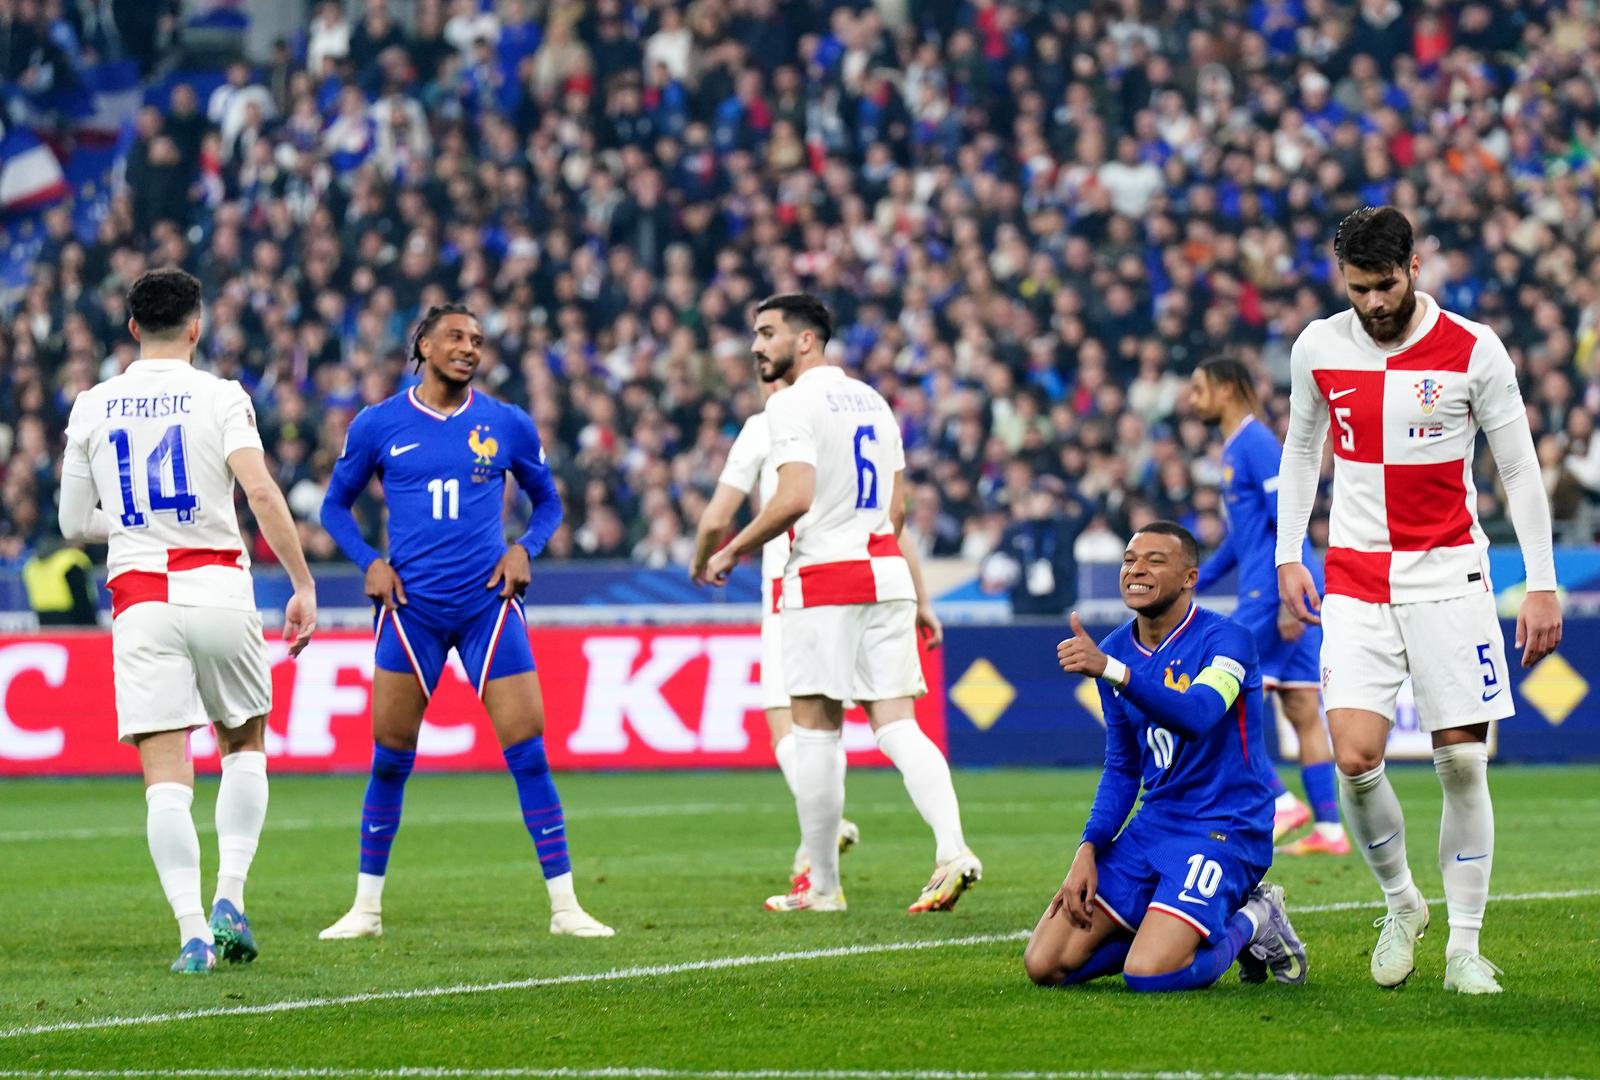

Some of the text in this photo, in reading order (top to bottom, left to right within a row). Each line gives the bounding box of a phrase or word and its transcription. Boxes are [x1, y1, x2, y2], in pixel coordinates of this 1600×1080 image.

[1334, 407, 1356, 452] 5
[108, 423, 201, 529] 14
[853, 424, 880, 511] 6
[427, 478, 460, 520] 11
[1476, 643, 1498, 686] 5
[1146, 726, 1175, 770] 10
[1183, 853, 1224, 898] 10
